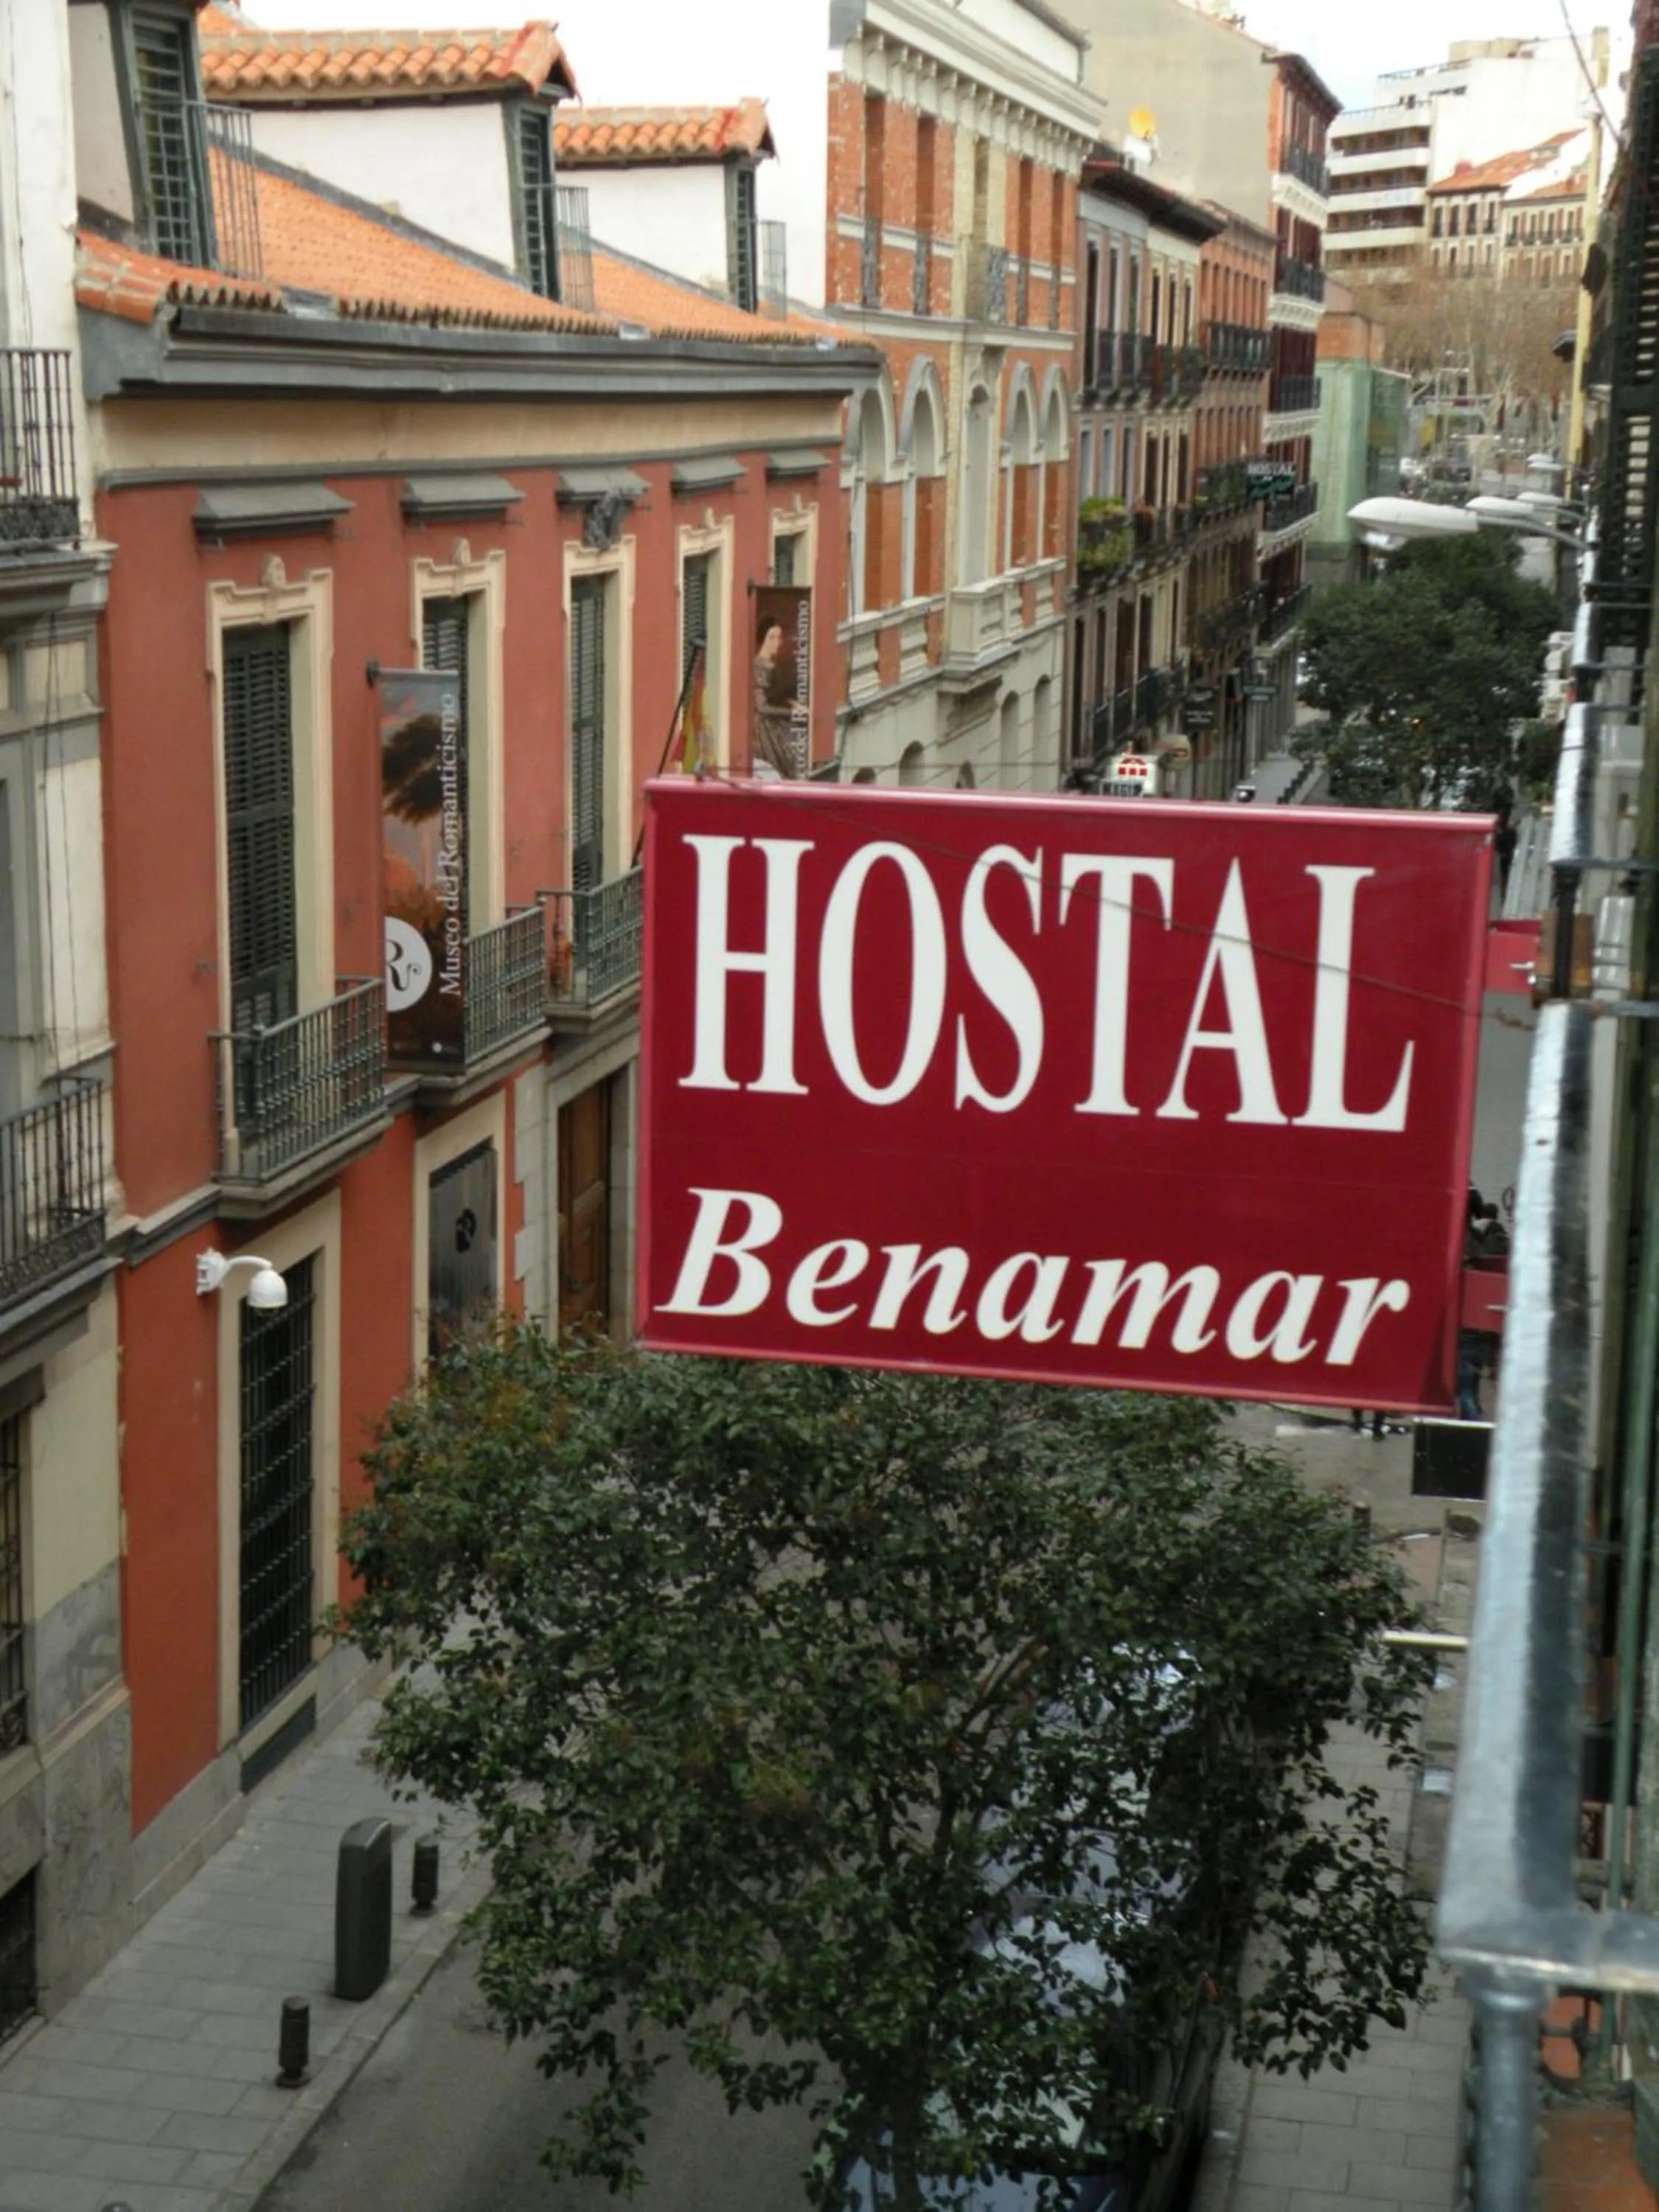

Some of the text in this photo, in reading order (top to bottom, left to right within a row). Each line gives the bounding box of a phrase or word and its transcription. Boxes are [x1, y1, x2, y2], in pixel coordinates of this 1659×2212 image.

[1248, 462, 1295, 476] HOSTAL
[790, 600, 809, 722] Romanticismo
[436, 692, 462, 995] Museo del Romanticismo
[678, 834, 1413, 1132] HOSTAL
[654, 1188, 1410, 1365] Benamar
